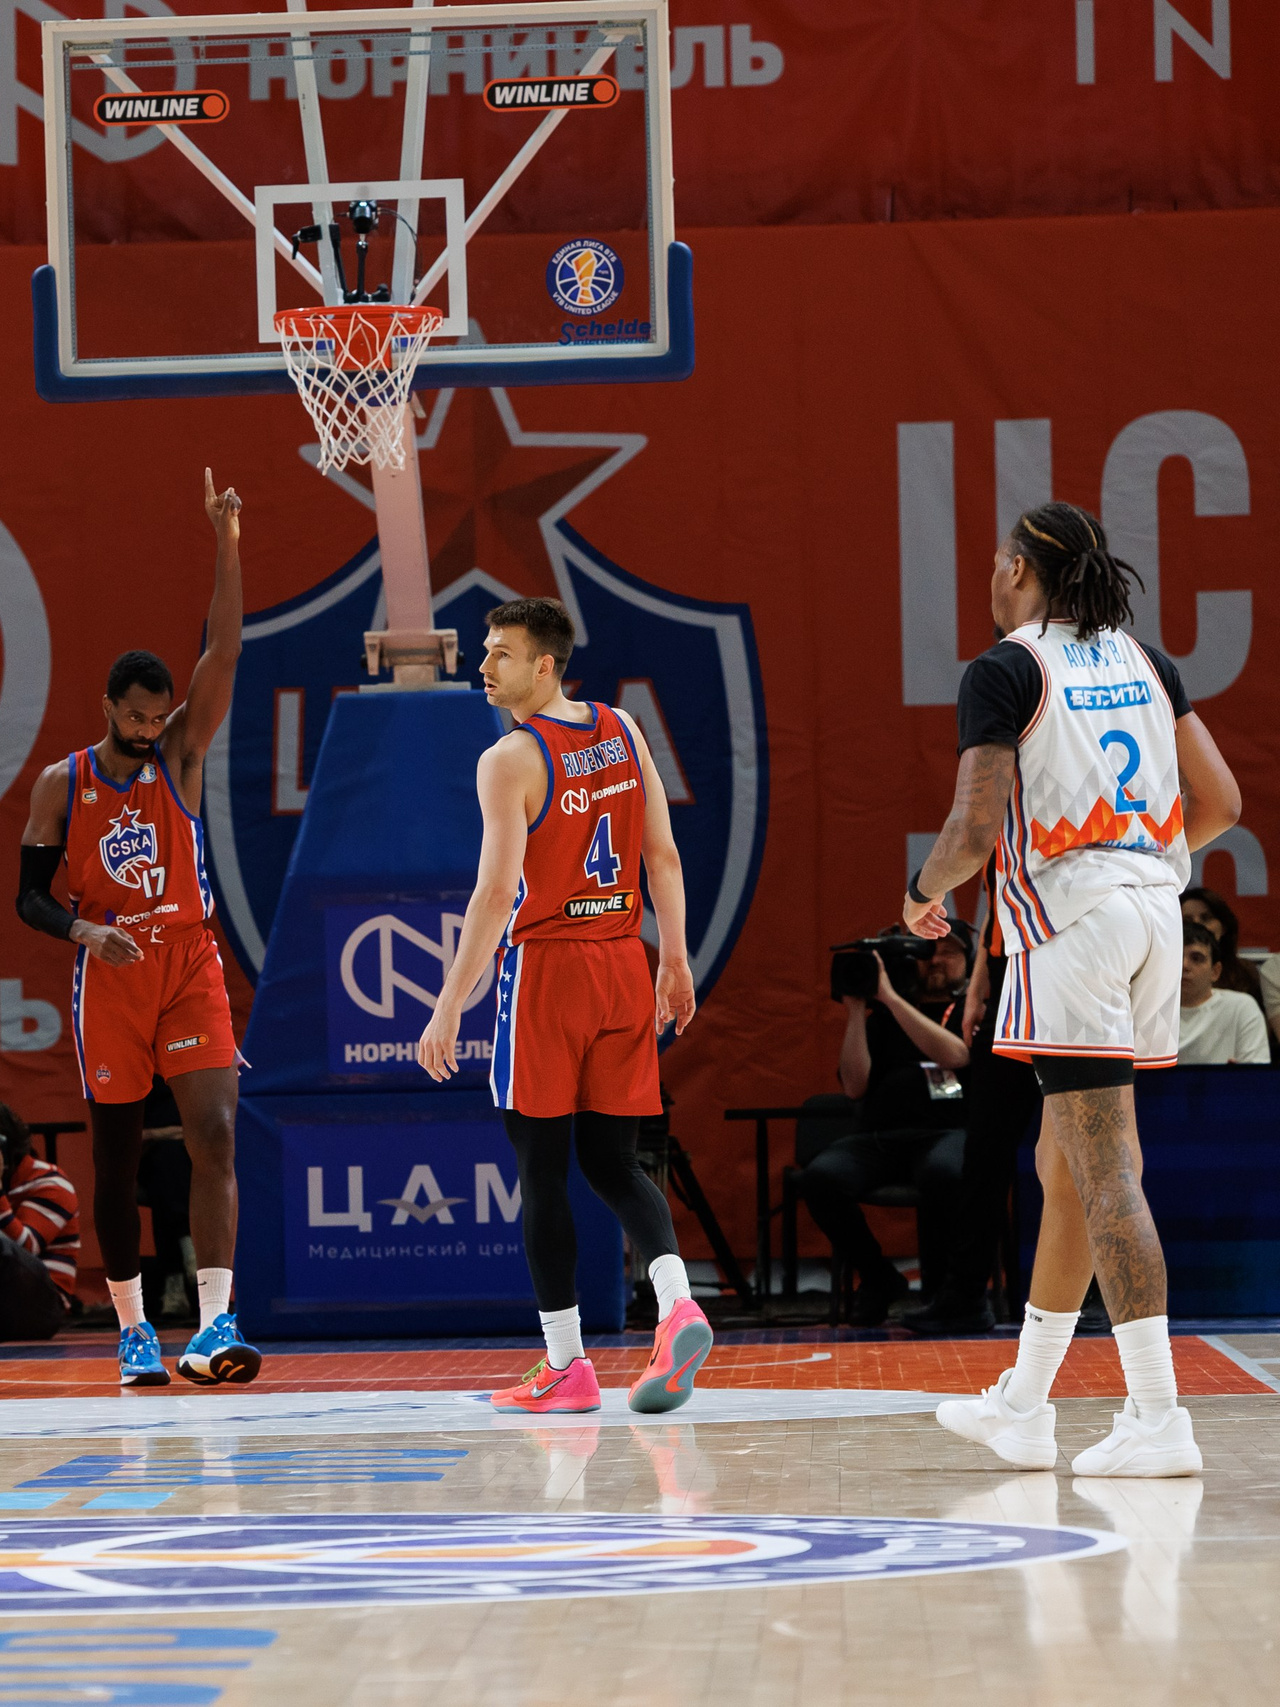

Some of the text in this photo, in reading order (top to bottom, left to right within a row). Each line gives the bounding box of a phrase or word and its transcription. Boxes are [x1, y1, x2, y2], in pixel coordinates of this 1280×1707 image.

[494, 82, 590, 105] WINLINE
[104, 97, 199, 119] WINLINE
[551, 240, 618, 265] ЕДИНАЯ ЛИГА ВТБ
[552, 290, 620, 315] VTB UNITED LEAGUE
[558, 318, 651, 345] Schelde
[1099, 730, 1147, 813] 2
[109, 834, 152, 857] CSKA
[584, 812, 622, 888] 4
[142, 866, 165, 899] 17
[167, 1037, 198, 1052] WINLINE
[307, 1162, 523, 1232] ЦАМ
[308, 1241, 467, 1261] Медицинский
